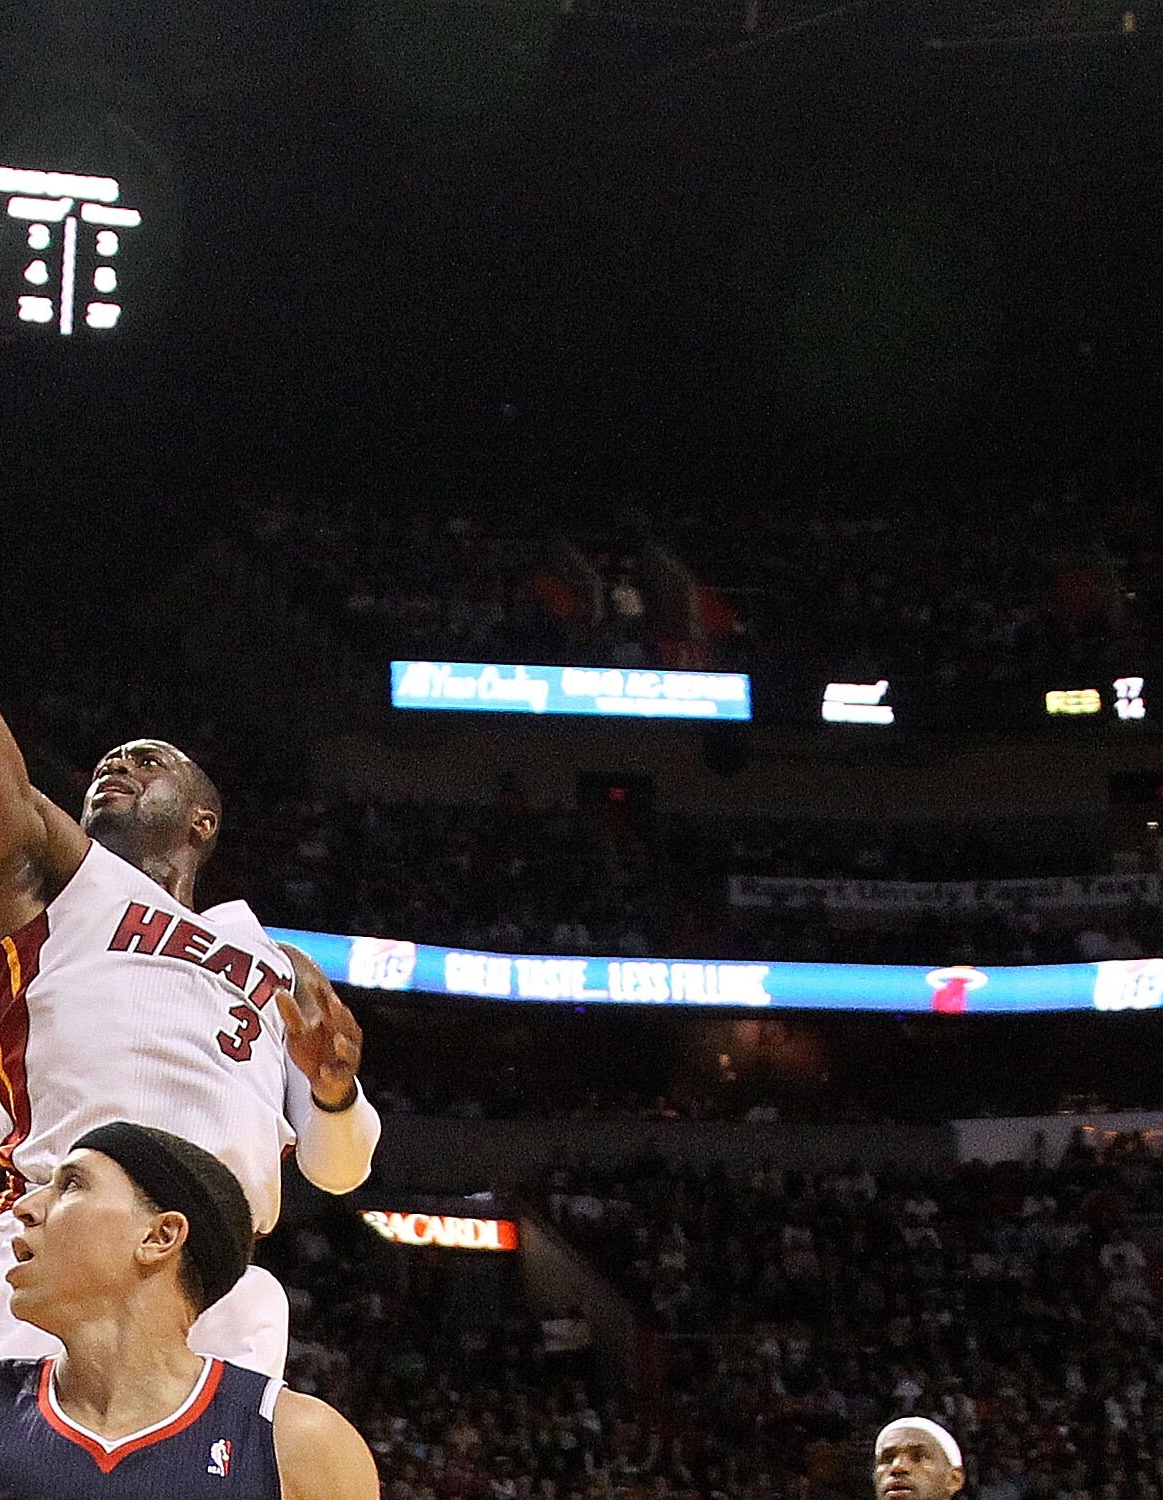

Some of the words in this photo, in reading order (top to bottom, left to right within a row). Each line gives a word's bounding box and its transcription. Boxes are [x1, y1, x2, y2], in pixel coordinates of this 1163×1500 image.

[106, 900, 294, 1011] HEAT
[609, 962, 669, 1002] LESS
[215, 1002, 264, 1063] 3
